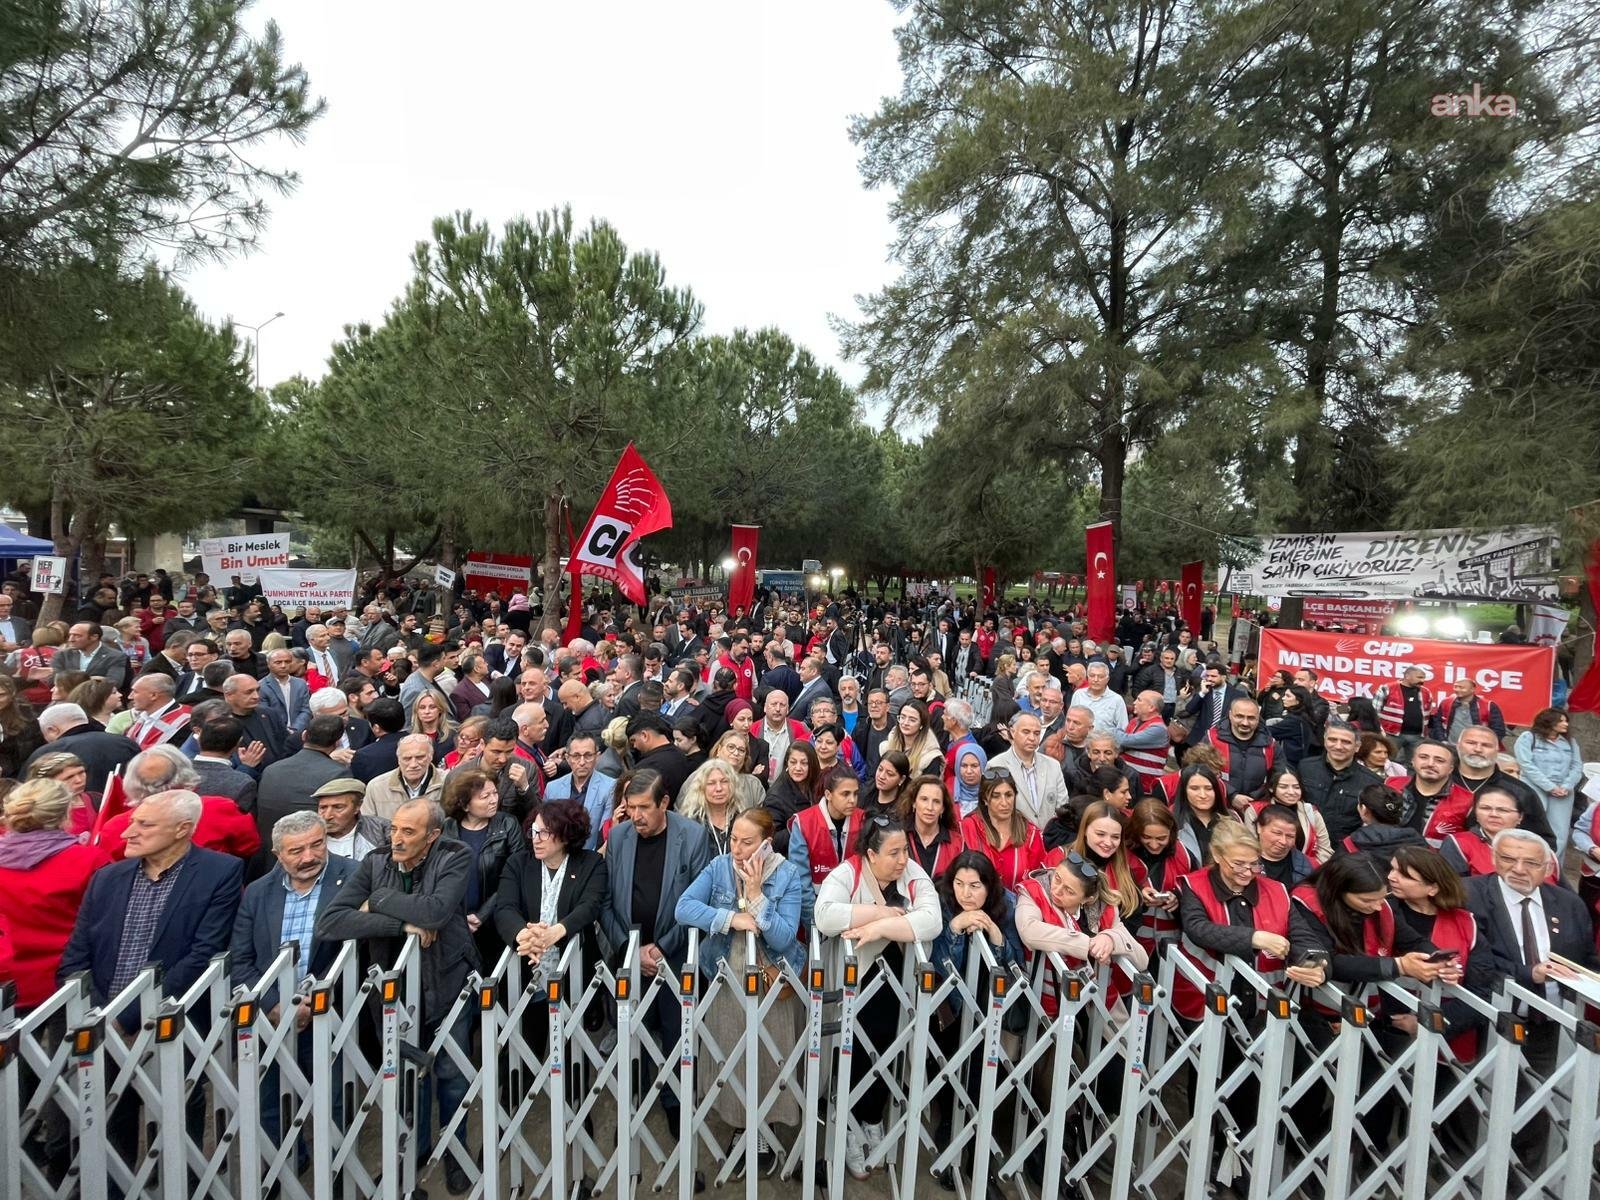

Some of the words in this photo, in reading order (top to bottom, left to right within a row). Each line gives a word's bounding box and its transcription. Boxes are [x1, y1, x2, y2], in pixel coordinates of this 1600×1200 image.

[228, 542, 243, 553] Bir
[245, 540, 281, 551] Meslek
[1270, 546, 1344, 563] EMEĞİNE
[220, 556, 243, 570] Bin
[247, 553, 289, 567] Umut!
[1262, 562, 1311, 579] SAHİP
[1303, 600, 1324, 611] İLÇE
[1327, 603, 1394, 614] BAŞKANLIĞI
[1363, 640, 1414, 657] CHP
[1279, 650, 1434, 681] MENDERES
[1443, 661, 1523, 690] İLÇE
